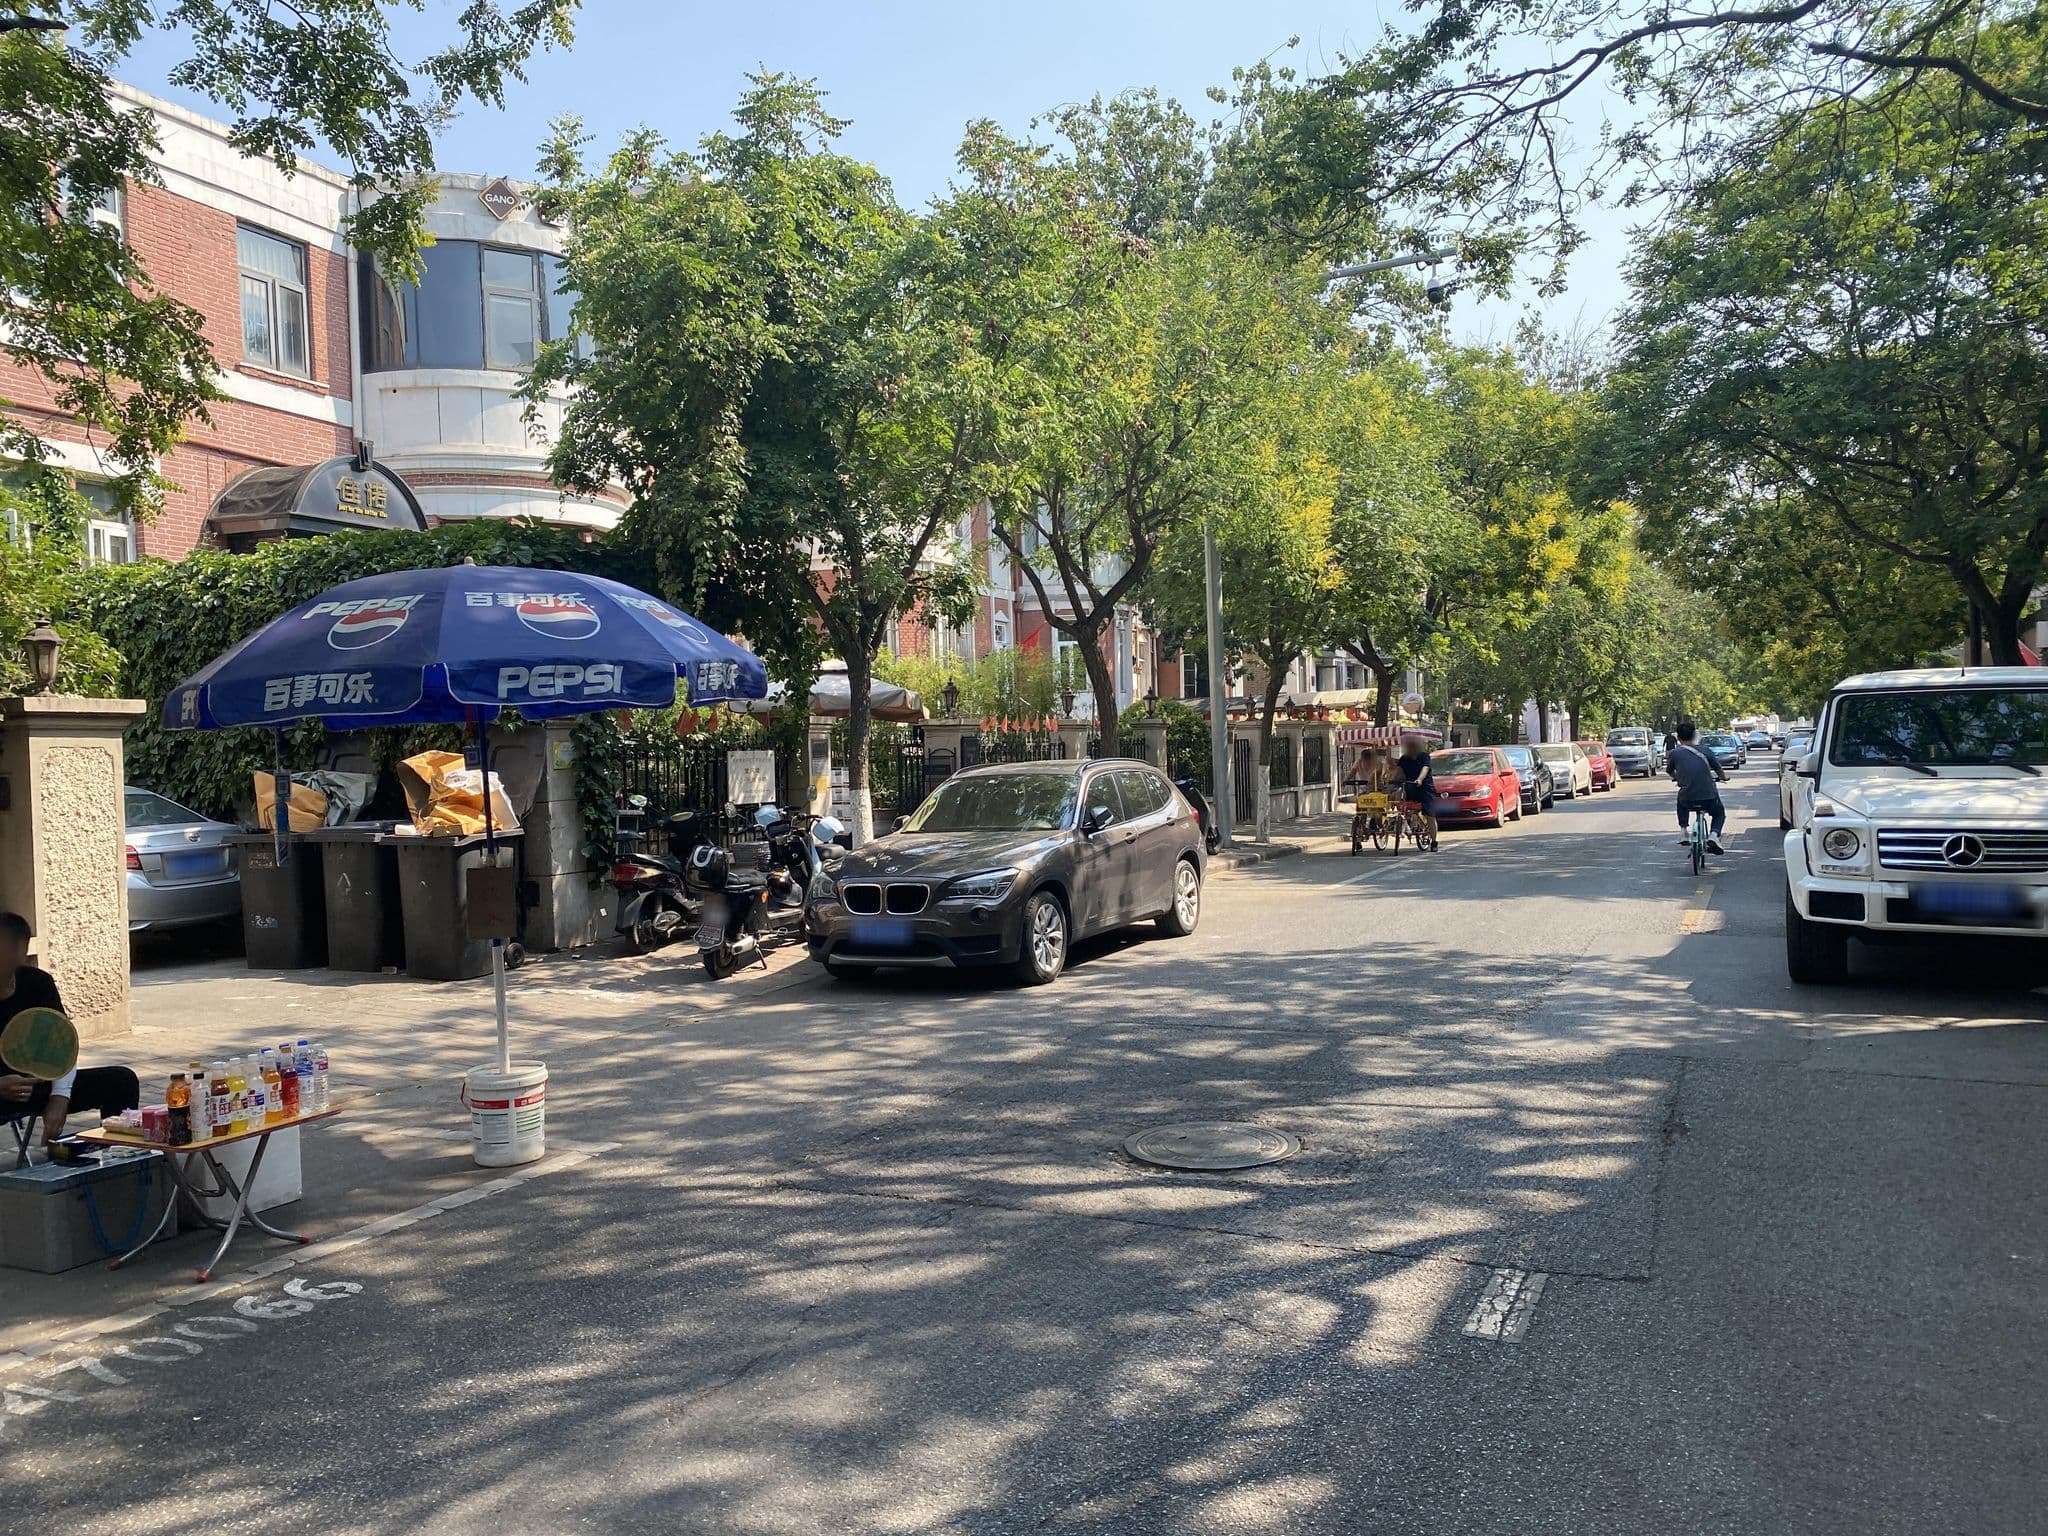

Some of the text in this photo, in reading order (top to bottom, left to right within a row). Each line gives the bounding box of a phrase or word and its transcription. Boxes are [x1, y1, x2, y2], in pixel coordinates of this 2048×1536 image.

[485, 193, 515, 205] GANO
[302, 594, 425, 619] PEPSI
[464, 591, 588, 607] 百事可乐
[264, 671, 377, 711] 百事可乐
[498, 664, 623, 698] PEPSI
